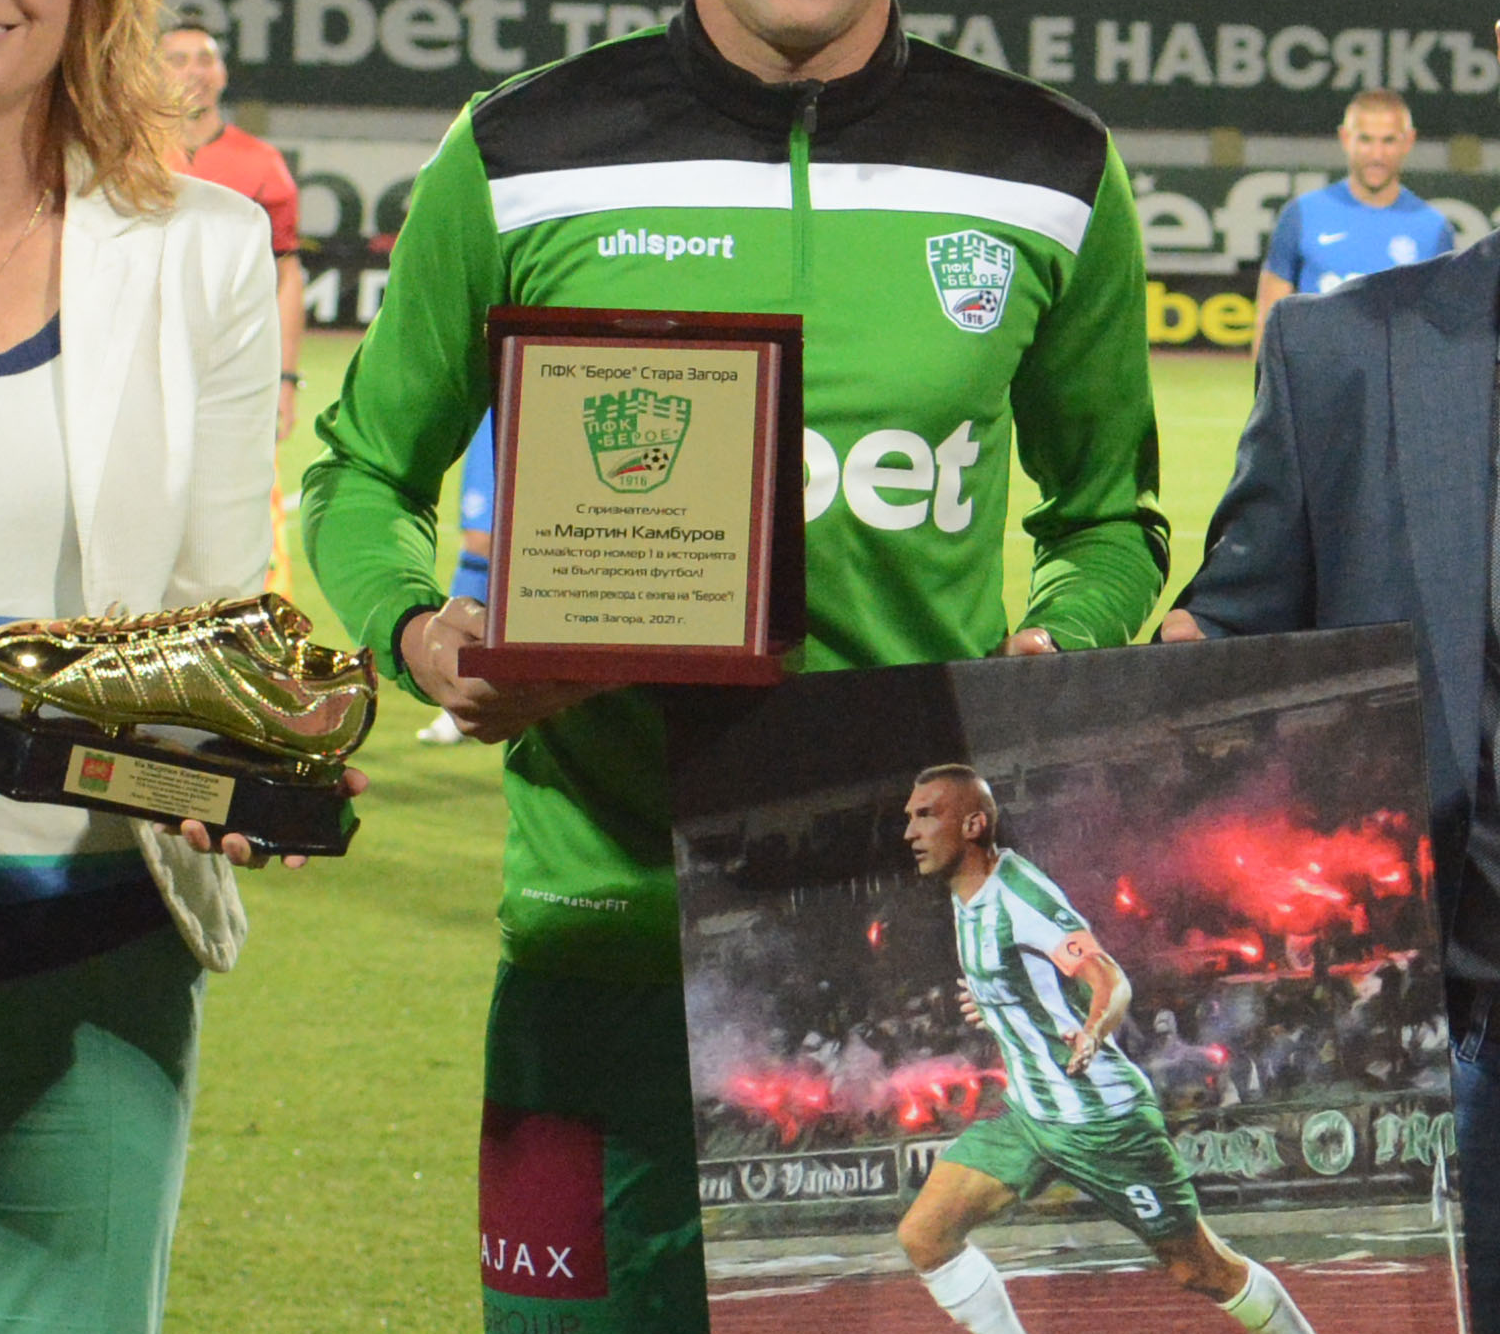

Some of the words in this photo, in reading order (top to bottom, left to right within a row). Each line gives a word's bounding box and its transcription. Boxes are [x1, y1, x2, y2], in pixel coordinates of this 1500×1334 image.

[1029, 16, 1076, 82] Е
[597, 228, 734, 261] uhlsport
[540, 364, 576, 378] ПФК
[640, 366, 684, 381] Стара
[687, 367, 738, 383] Загора
[588, 418, 631, 434] ПФК
[576, 504, 586, 514] С
[588, 506, 688, 517] признателност
[536, 529, 552, 538] на
[554, 524, 627, 541] Мартин
[631, 525, 725, 542] Камбуров
[522, 546, 601, 559] голмайстор
[603, 549, 646, 560] номер
[666, 551, 737, 562] историята
[552, 567, 569, 575] на
[571, 565, 648, 578] българския
[650, 567, 704, 579] футбол!
[520, 587, 534, 598] За
[564, 613, 599, 624] Стара
[481, 1233, 574, 1279] AJAX
